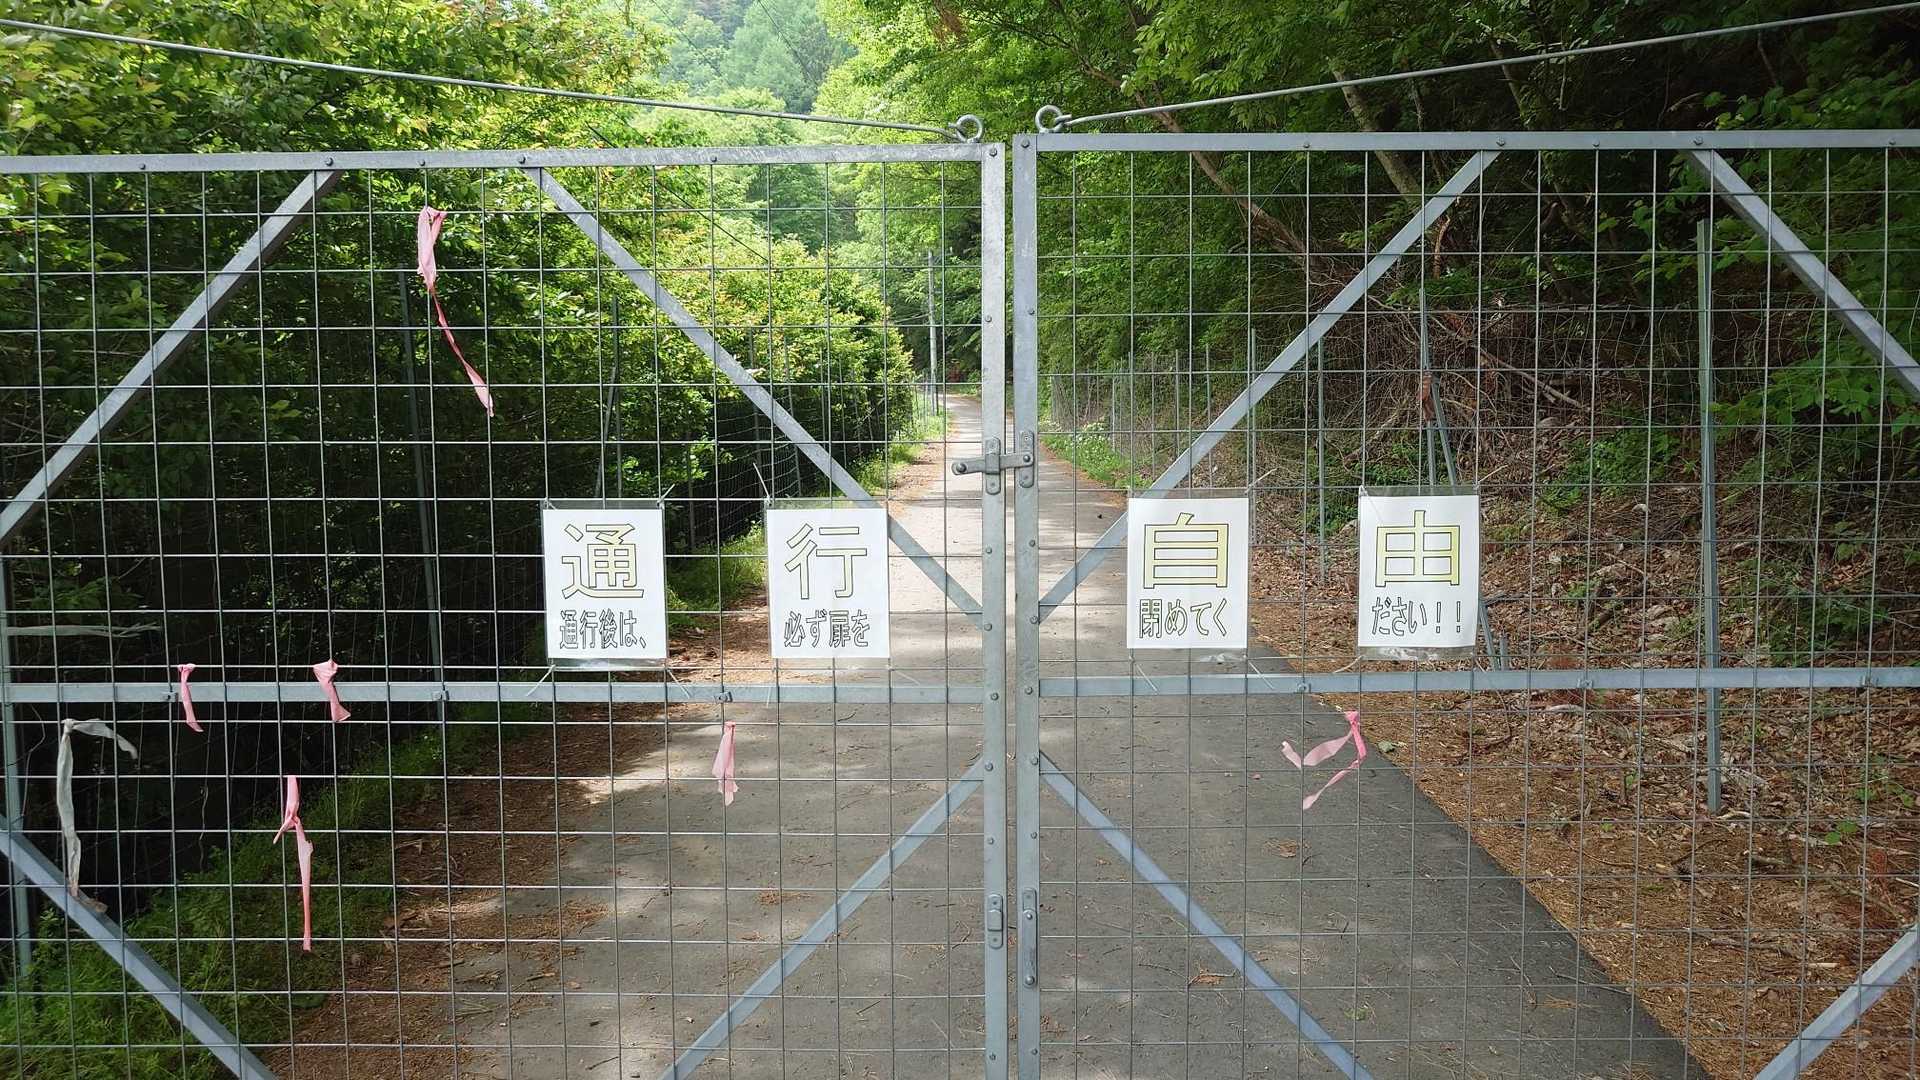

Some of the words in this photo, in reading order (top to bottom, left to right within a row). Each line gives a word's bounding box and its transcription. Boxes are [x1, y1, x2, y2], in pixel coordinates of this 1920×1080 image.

[561, 523, 644, 599] 通
[784, 523, 868, 600] 行
[1143, 511, 1229, 589] 自
[1375, 509, 1460, 587] 由
[783, 609, 871, 648] 必ず扉を
[1138, 598, 1228, 639] 閉めてく
